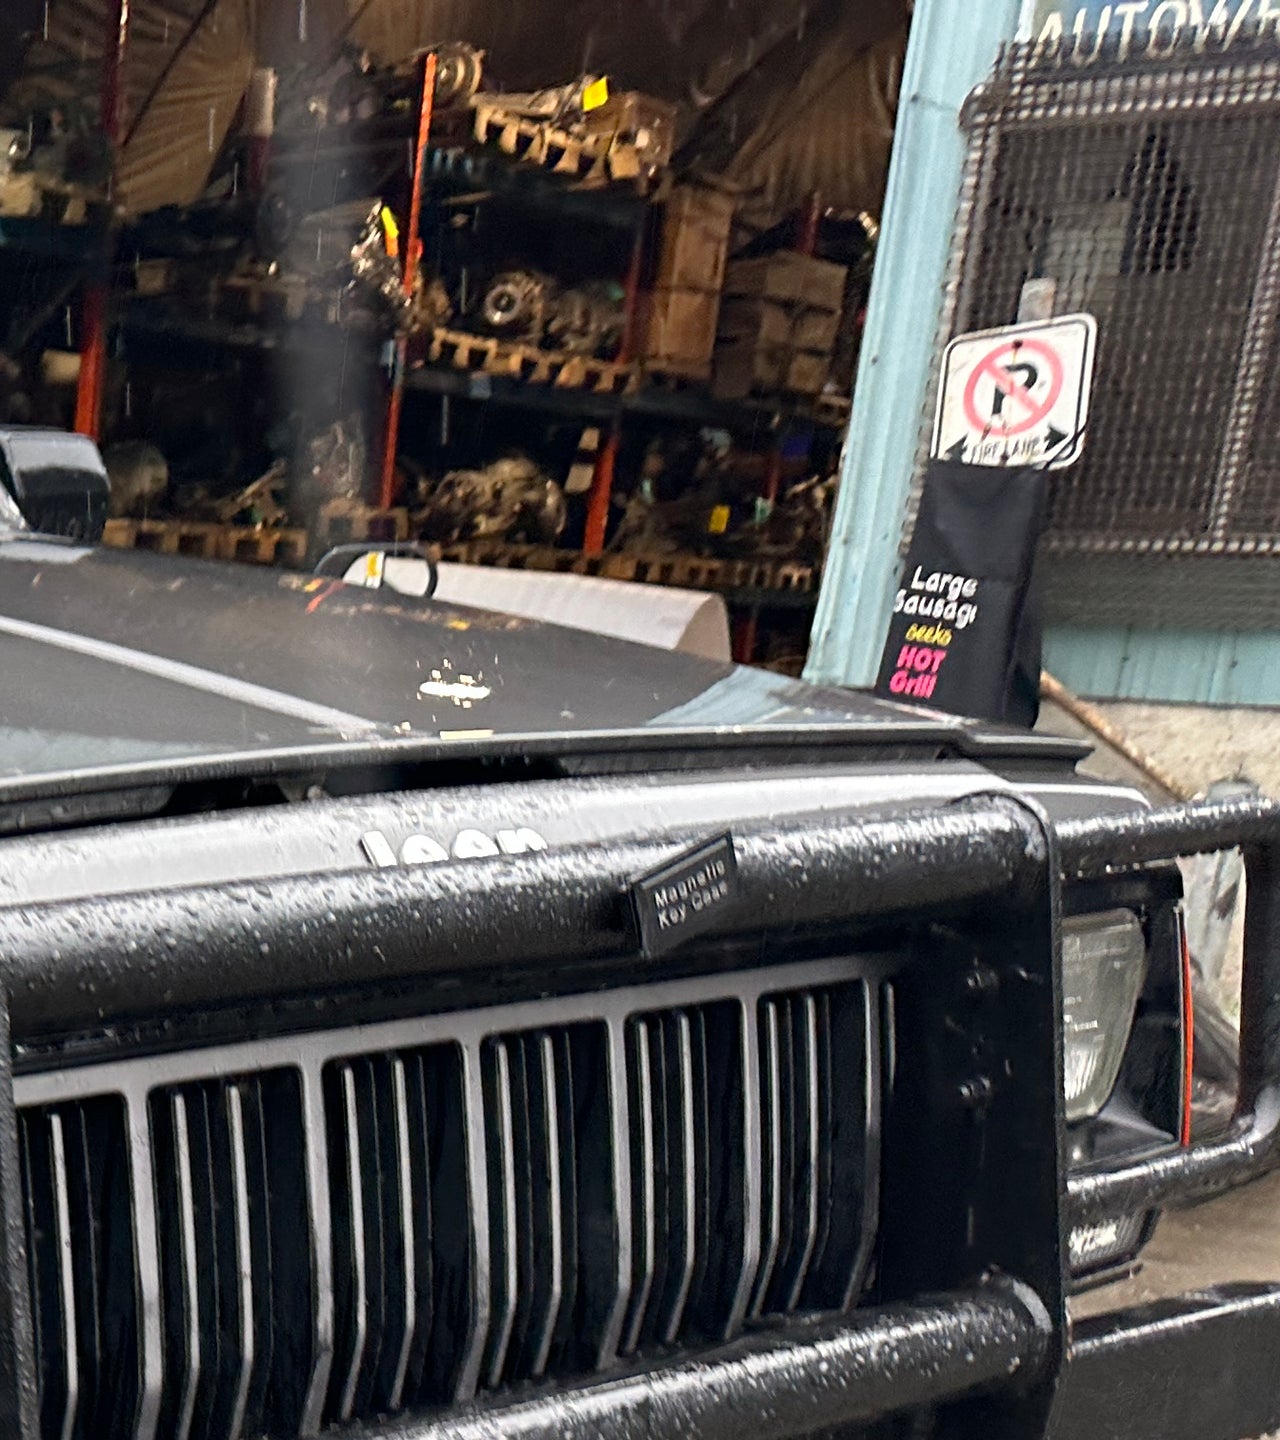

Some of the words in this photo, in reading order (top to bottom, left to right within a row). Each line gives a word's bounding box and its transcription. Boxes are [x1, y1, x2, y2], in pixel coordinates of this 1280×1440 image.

[911, 565, 978, 601] Large
[897, 645, 947, 673] HOT
[890, 670, 937, 698] Grill
[654, 859, 726, 908] Magnetic
[658, 903, 687, 930] Key
[691, 880, 728, 911] Case
